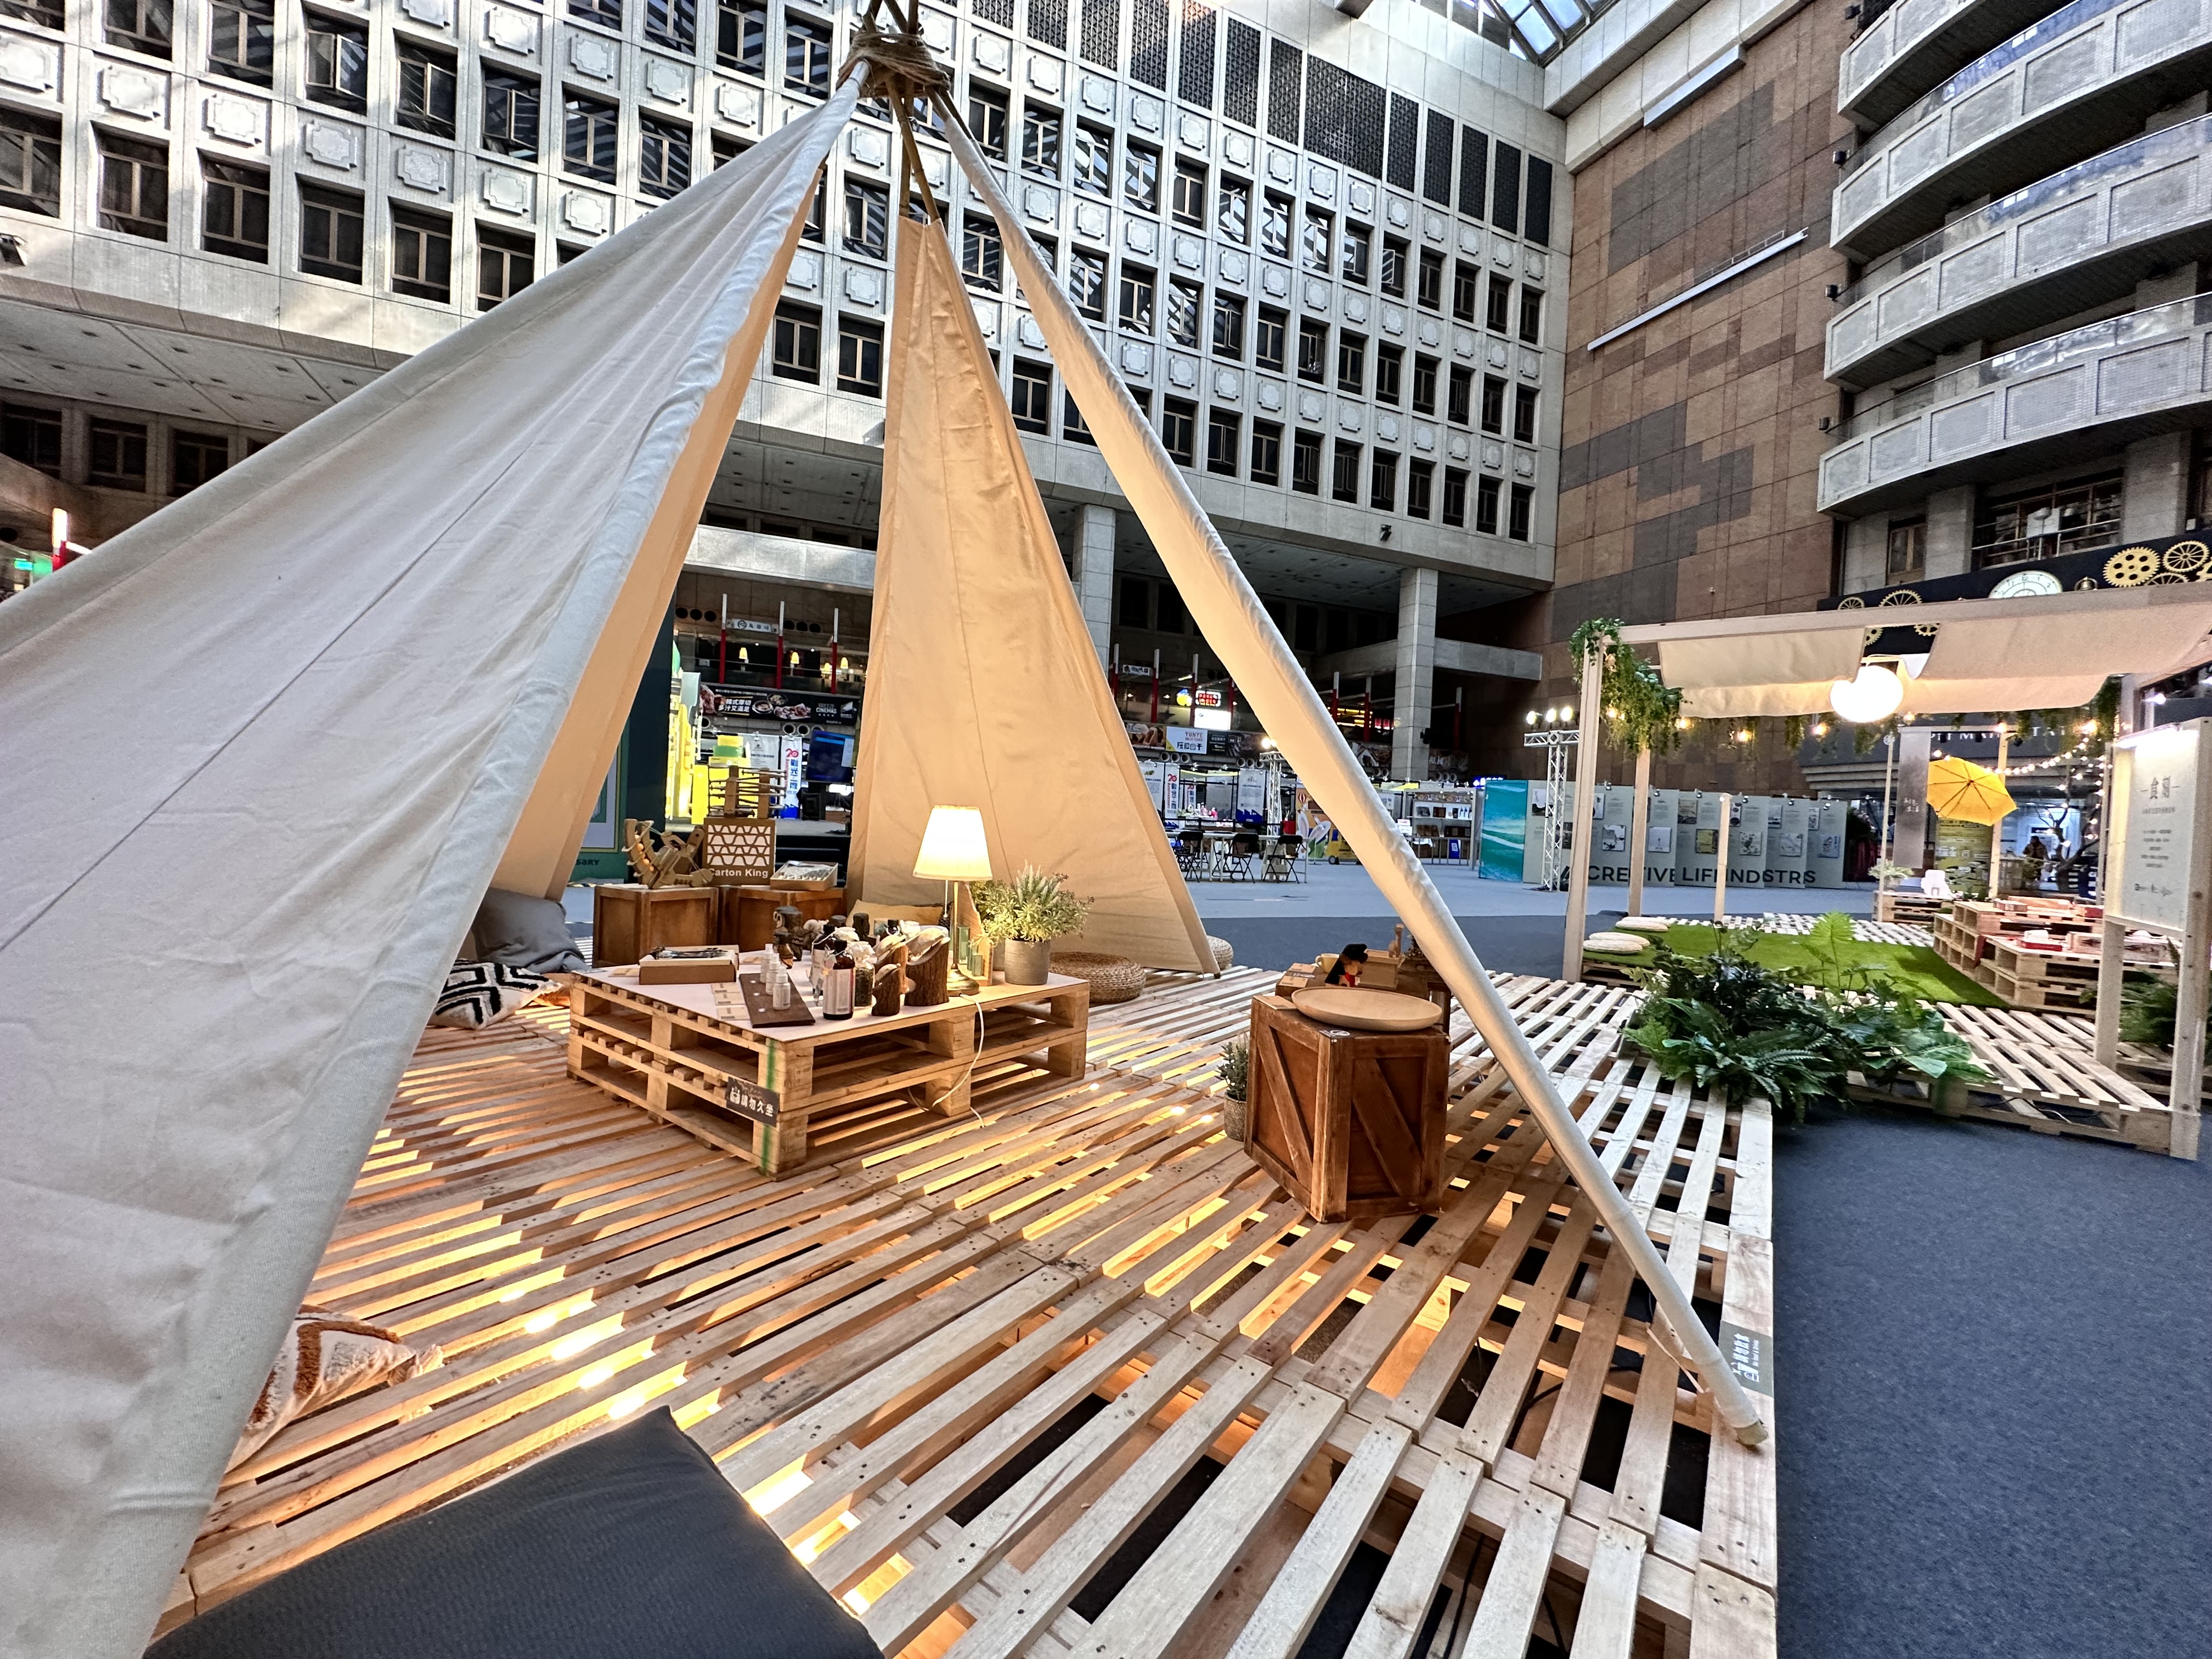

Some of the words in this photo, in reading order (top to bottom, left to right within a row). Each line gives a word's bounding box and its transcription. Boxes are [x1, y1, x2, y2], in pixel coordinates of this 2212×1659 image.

[745, 868, 769, 879] King
[1588, 865, 1675, 883] CREIVE
[1683, 867, 1718, 883] LIF
